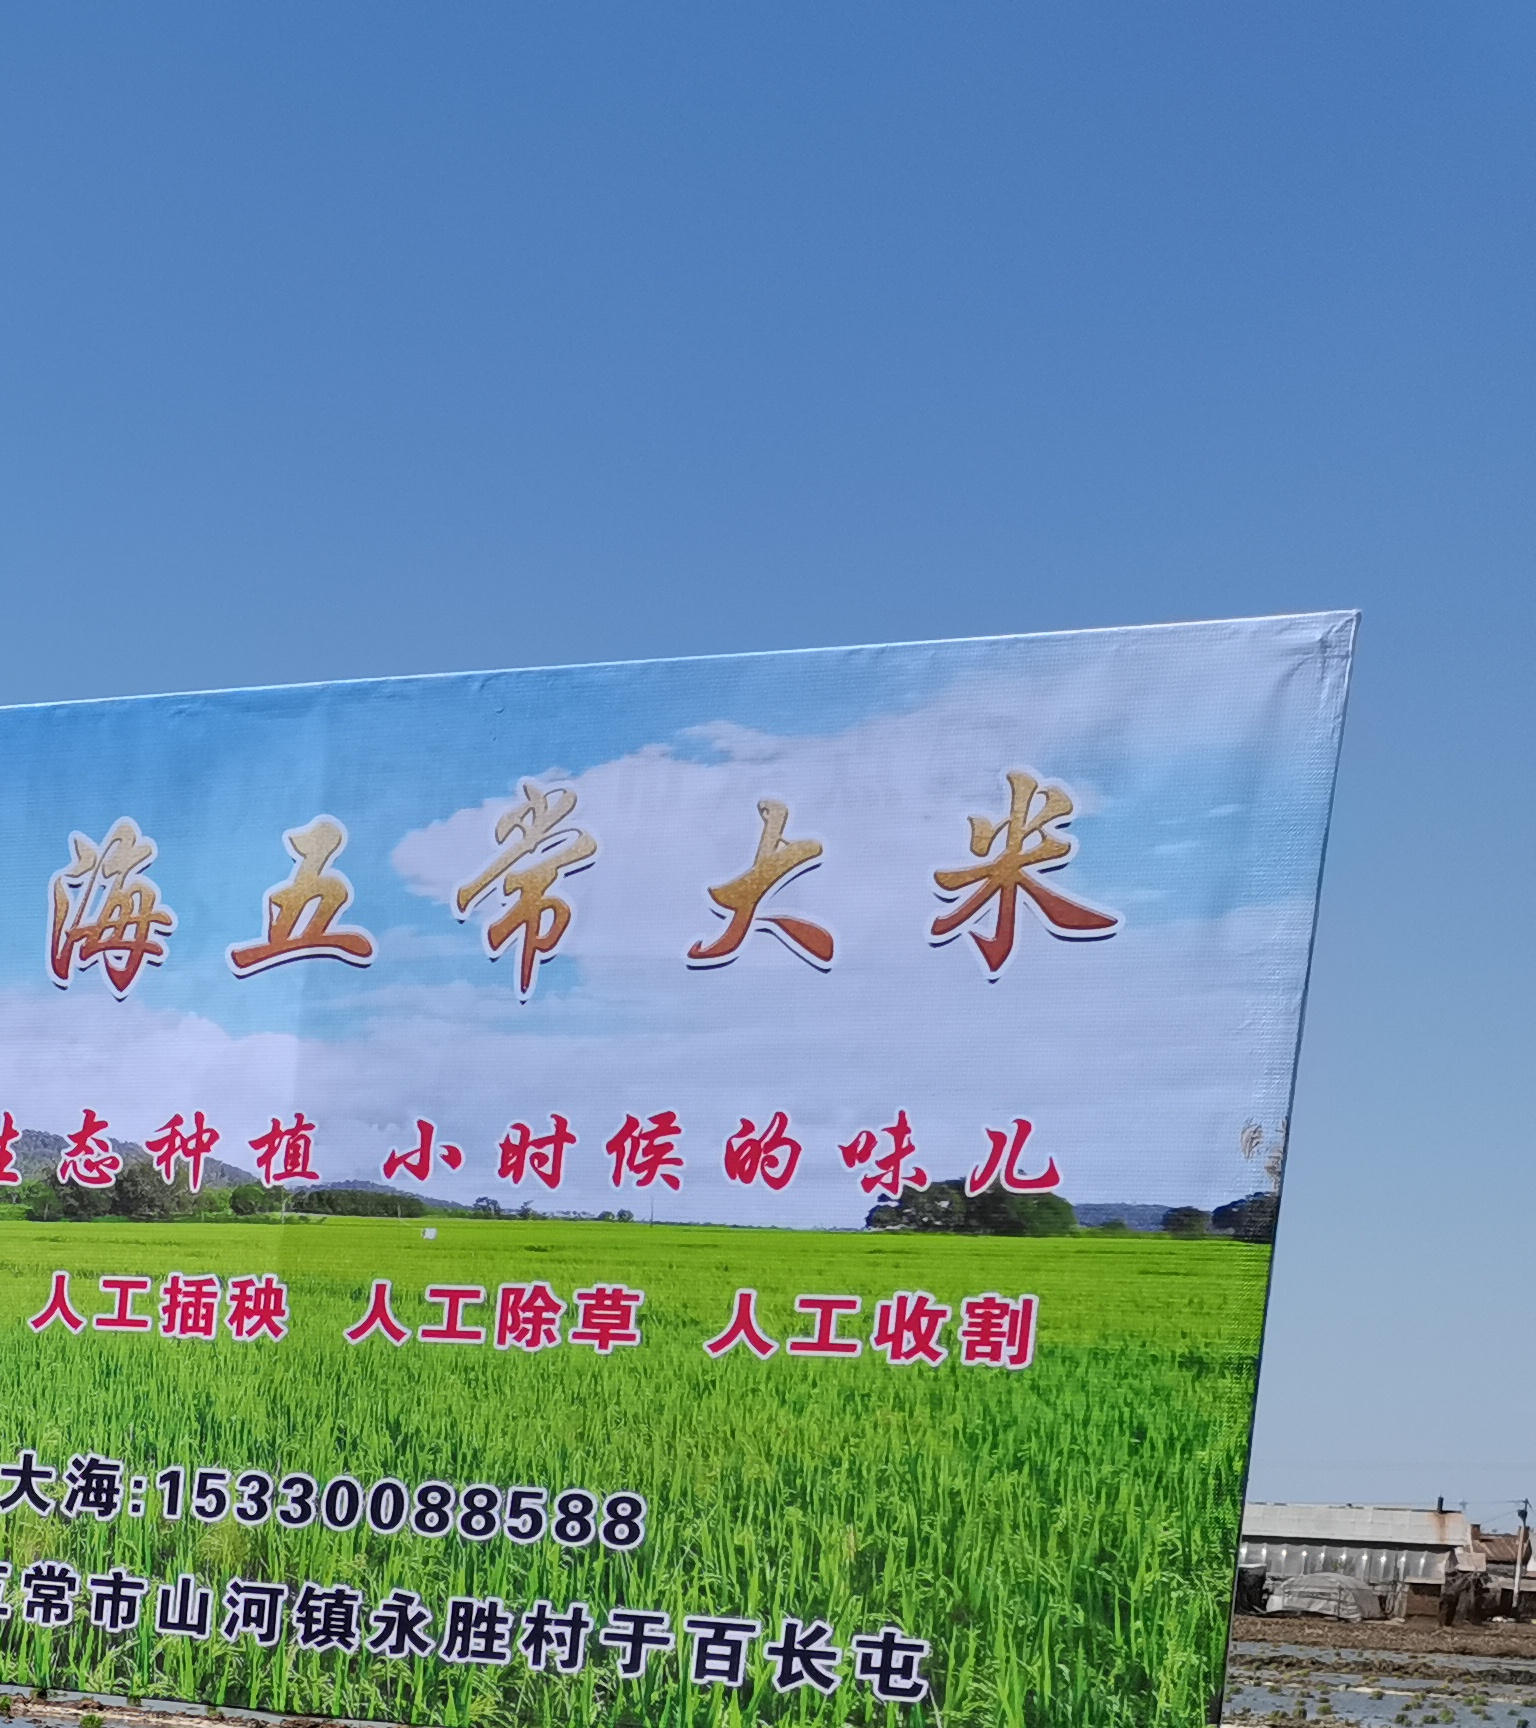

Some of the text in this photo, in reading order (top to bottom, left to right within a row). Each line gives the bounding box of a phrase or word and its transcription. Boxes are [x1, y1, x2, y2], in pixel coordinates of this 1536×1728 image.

[383, 1110, 1060, 1194] 小时候的味儿
[31, 1275, 286, 1339] 人工插秧
[344, 1282, 640, 1352] 人工除草
[707, 1290, 1036, 1366] 人工收割
